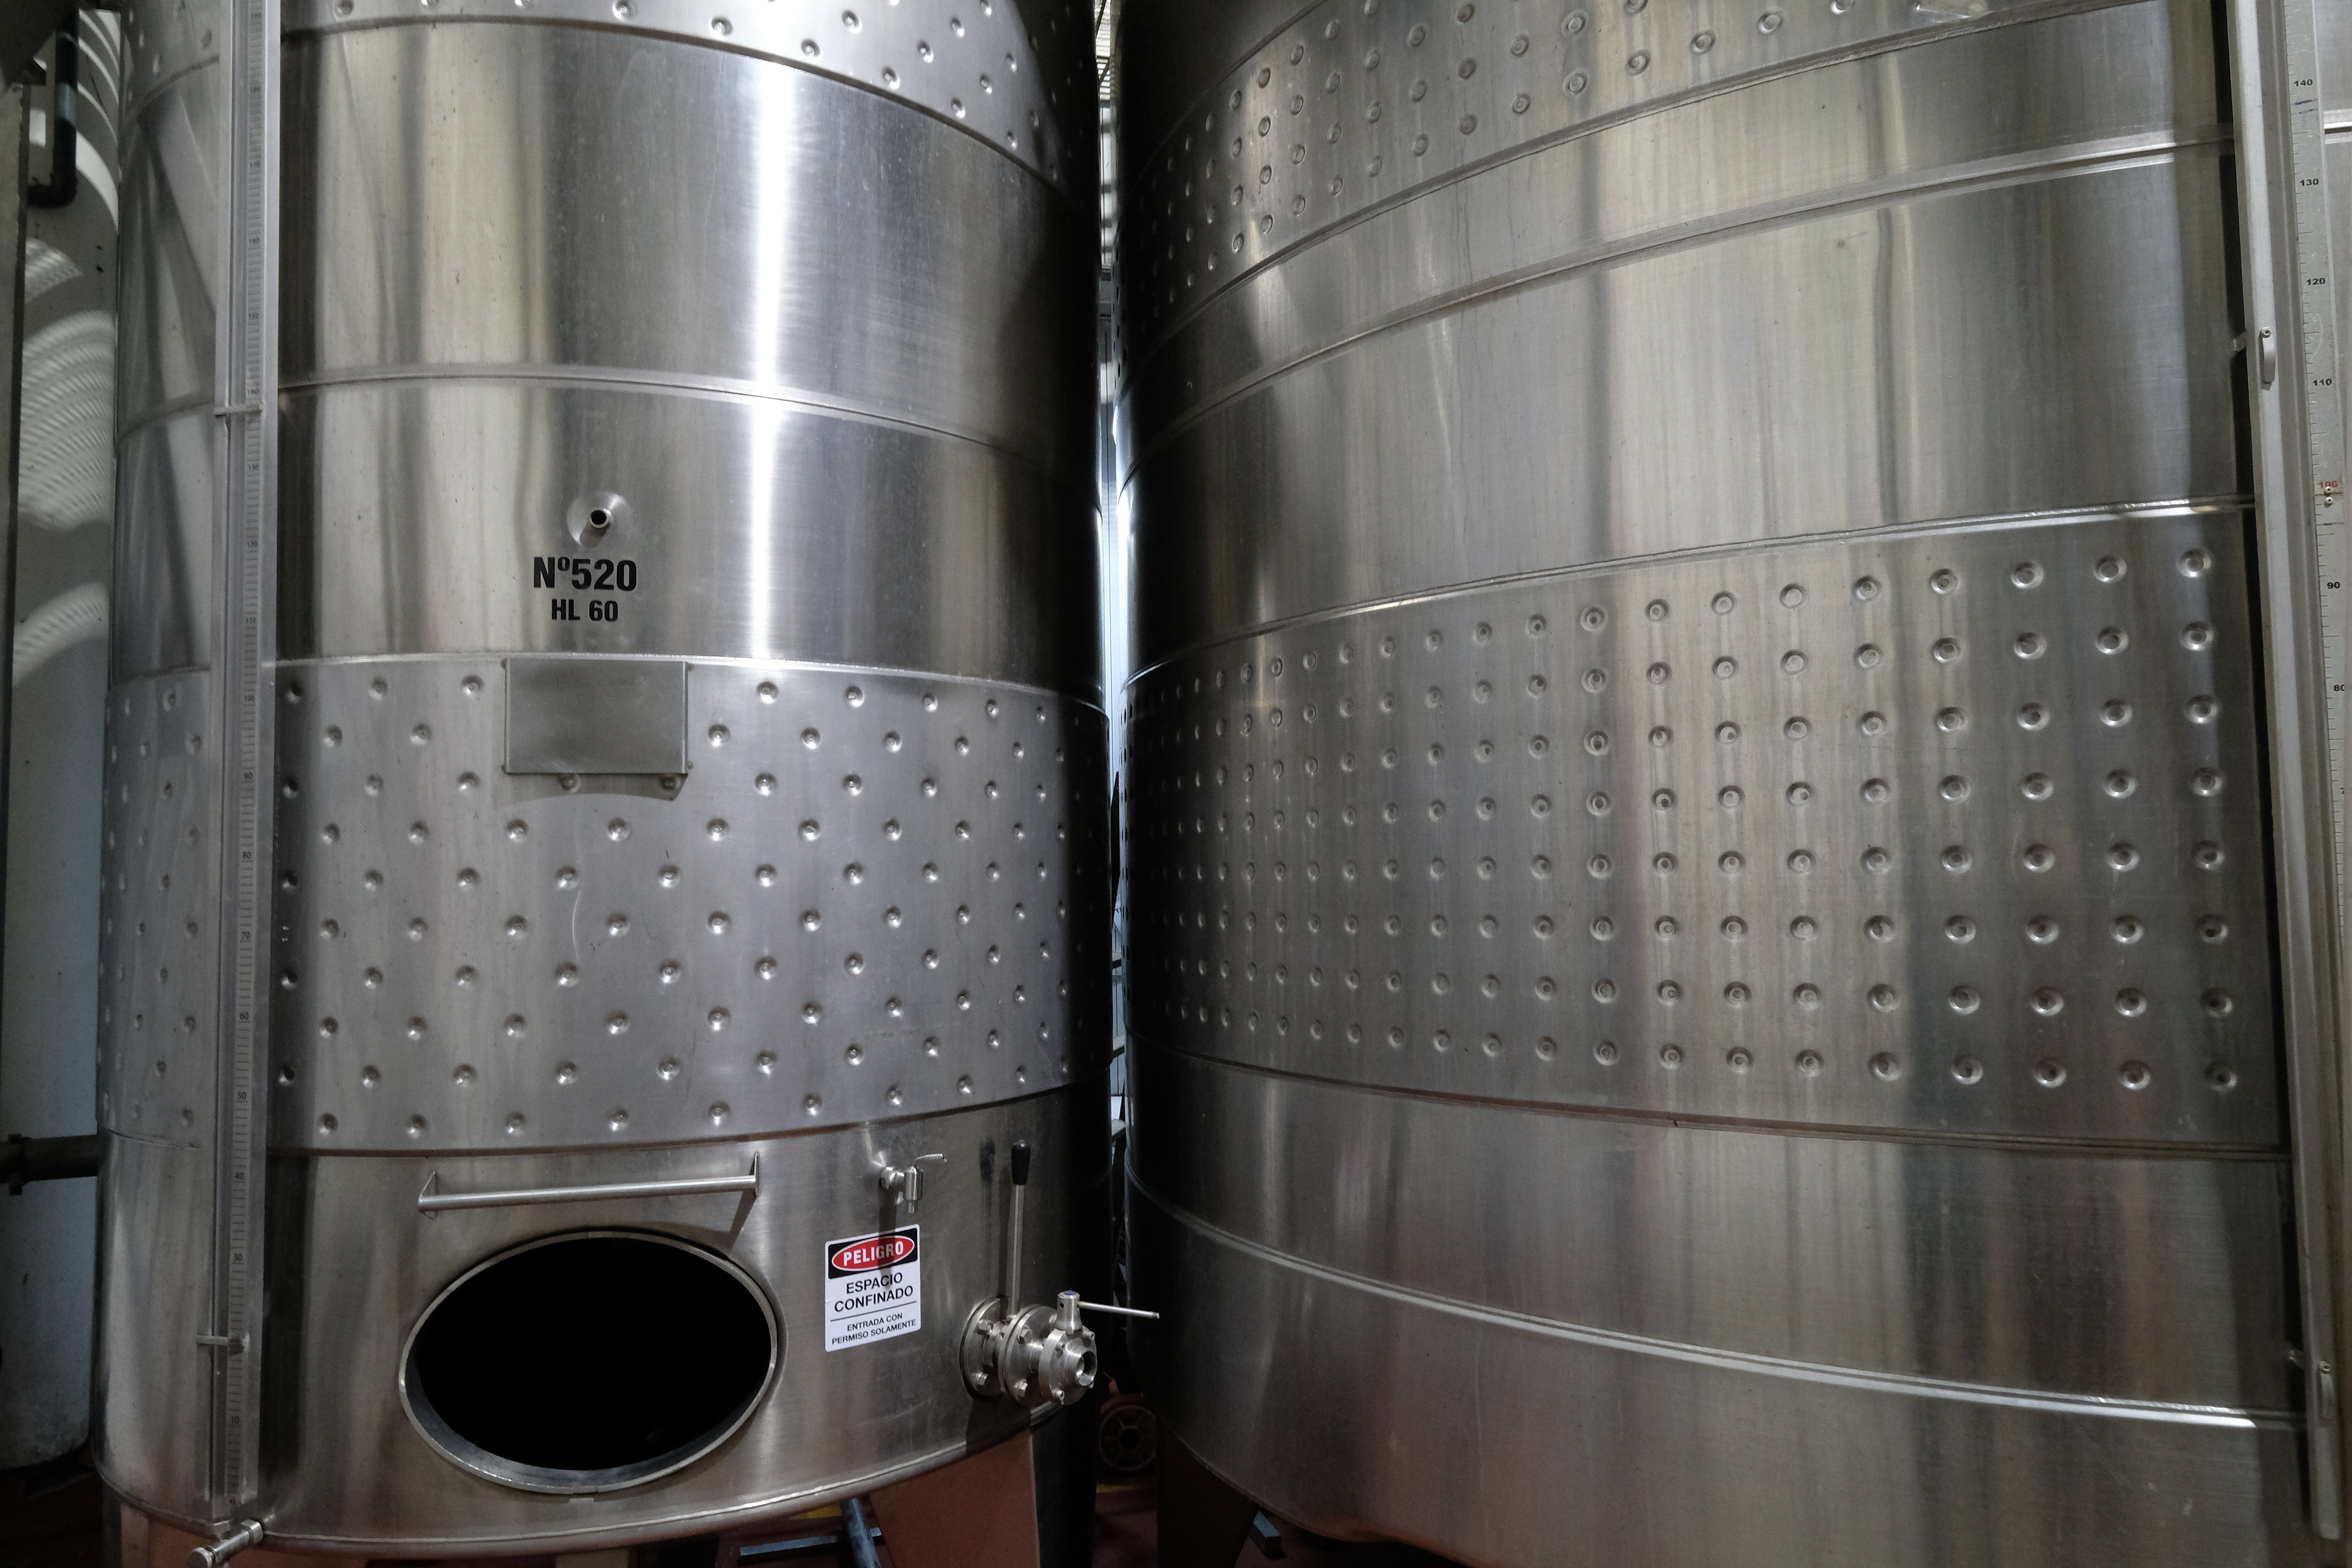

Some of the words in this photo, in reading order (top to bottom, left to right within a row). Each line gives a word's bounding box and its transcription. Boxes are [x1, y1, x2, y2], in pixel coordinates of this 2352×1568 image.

[551, 599, 580, 620] HL
[589, 600, 619, 622] 60
[244, 772, 253, 780] 90
[243, 851, 252, 860] 80
[241, 931, 251, 940] 70
[239, 1012, 249, 1020] 60
[238, 1091, 247, 1101] 50
[235, 1172, 244, 1181] 40
[233, 1253, 243, 1262] 30
[843, 1240, 904, 1266] PELIGRO
[846, 1272, 903, 1294] ESPACIO
[834, 1286, 913, 1313] CONFINADO
[847, 1317, 884, 1332] ENTRADA
[886, 1312, 903, 1323] CON
[832, 1331, 869, 1345] PERMISO
[870, 1319, 916, 1336] SOLAMENTE
[230, 1415, 239, 1425] 10
